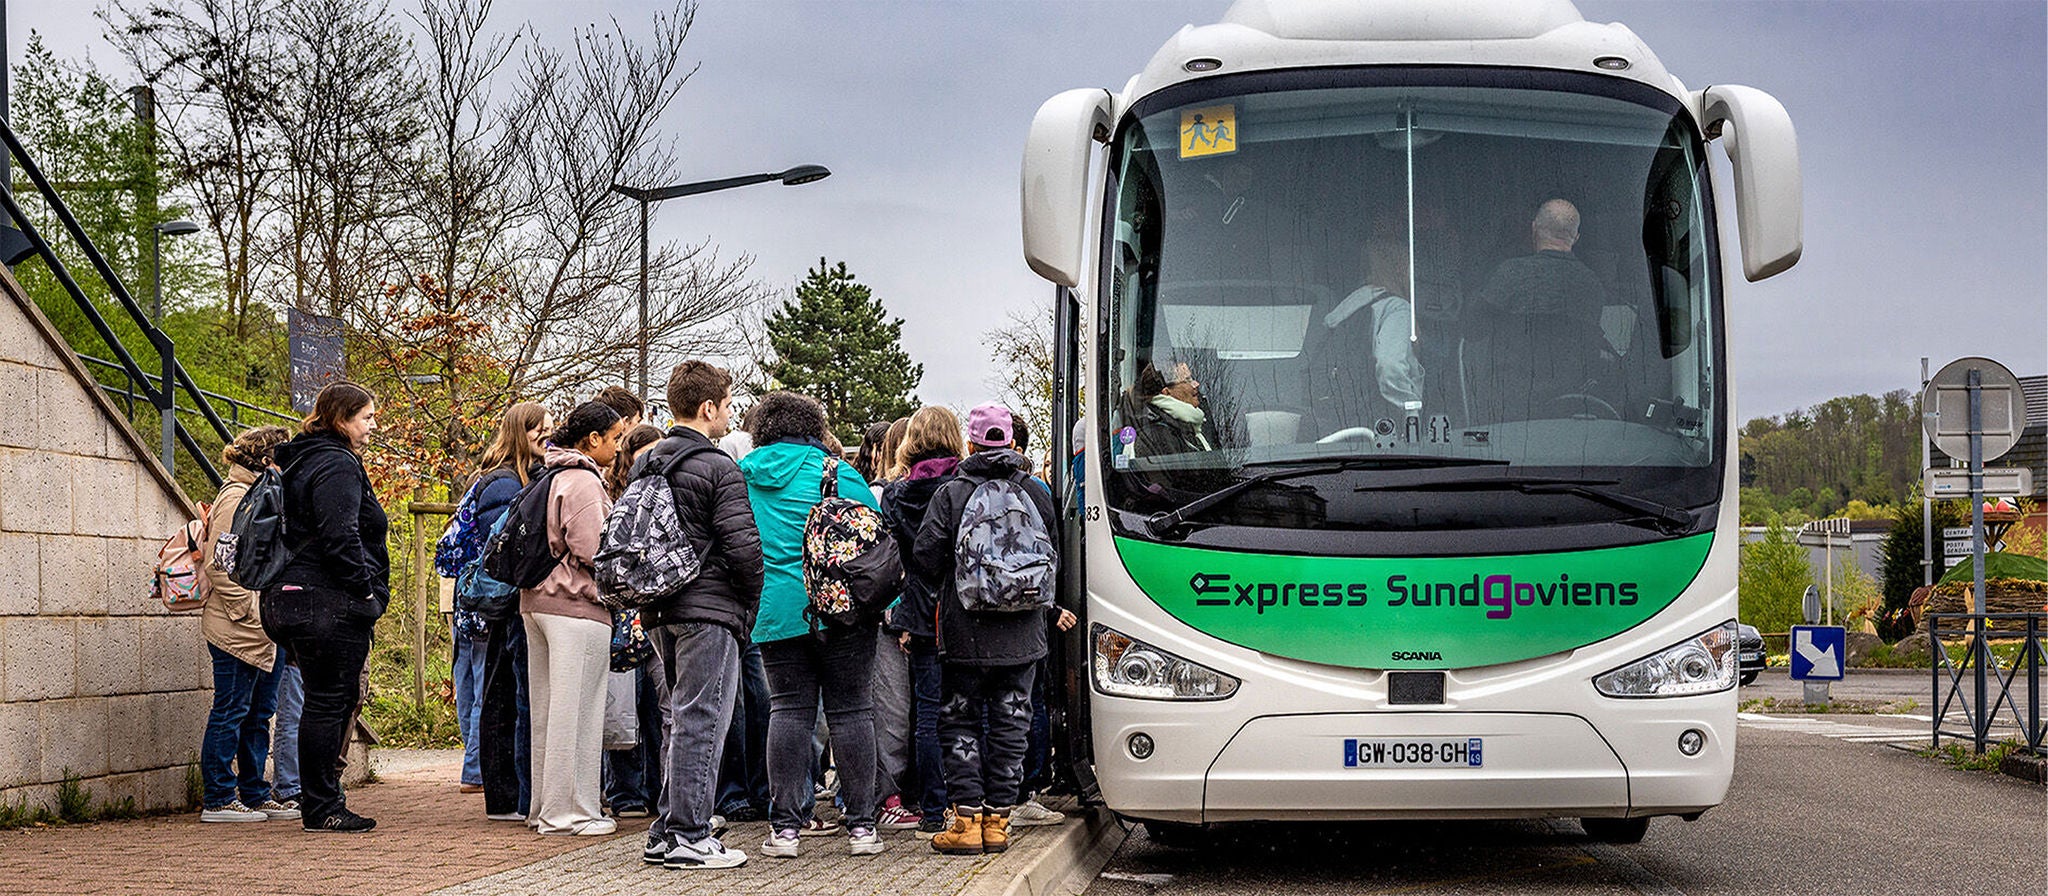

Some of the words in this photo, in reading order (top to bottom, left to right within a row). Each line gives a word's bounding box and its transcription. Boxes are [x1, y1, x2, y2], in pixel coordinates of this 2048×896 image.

[1190, 573, 1367, 615] Express
[1387, 573, 1639, 619] Sundgoviens
[1391, 651, 1442, 661] SCANIA
[1359, 743, 1467, 763] GW-038-GH
